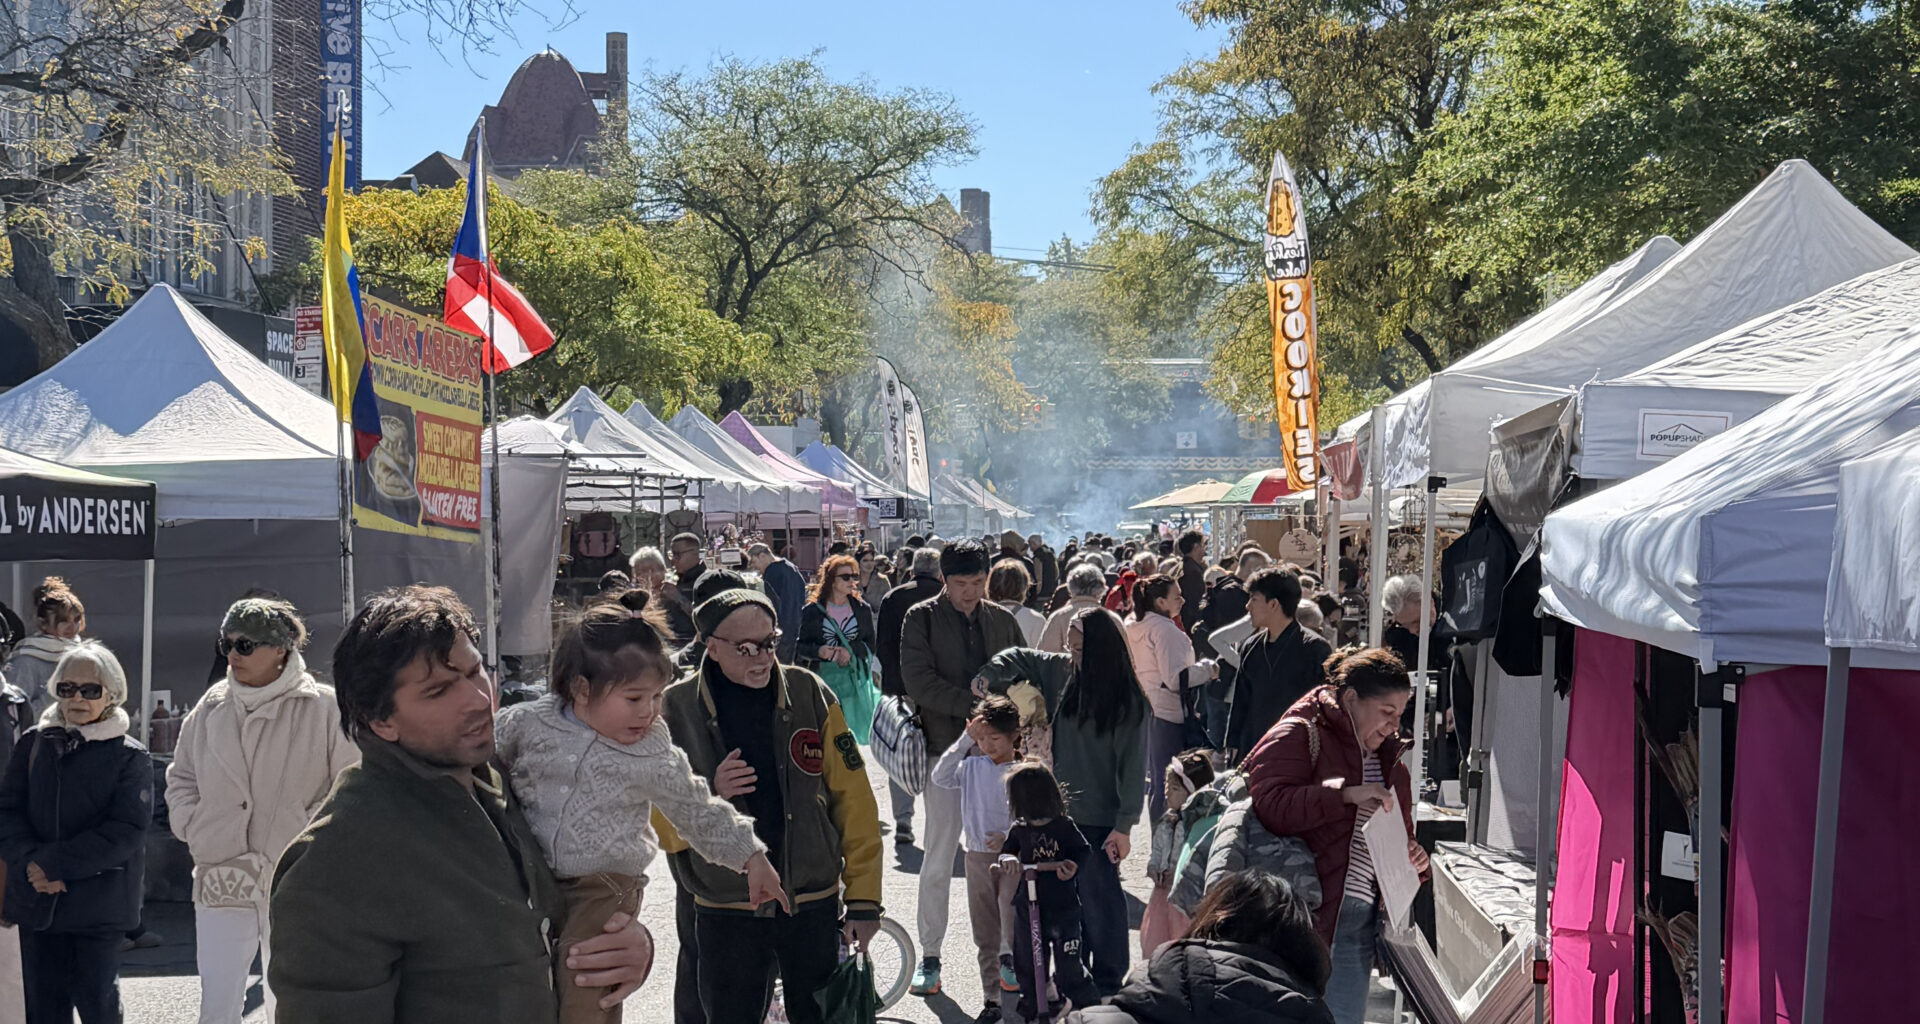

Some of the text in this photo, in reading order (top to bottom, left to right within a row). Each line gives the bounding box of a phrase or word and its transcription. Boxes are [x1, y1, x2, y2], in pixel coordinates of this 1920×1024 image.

[326, 0, 352, 55] ive
[266, 331, 294, 354] SPACE
[361, 299, 481, 388] SCAR'S AREPAS
[17, 494, 36, 534] by
[38, 496, 146, 535] ANDERSEN
[422, 487, 478, 522] GLUTEN FREE
